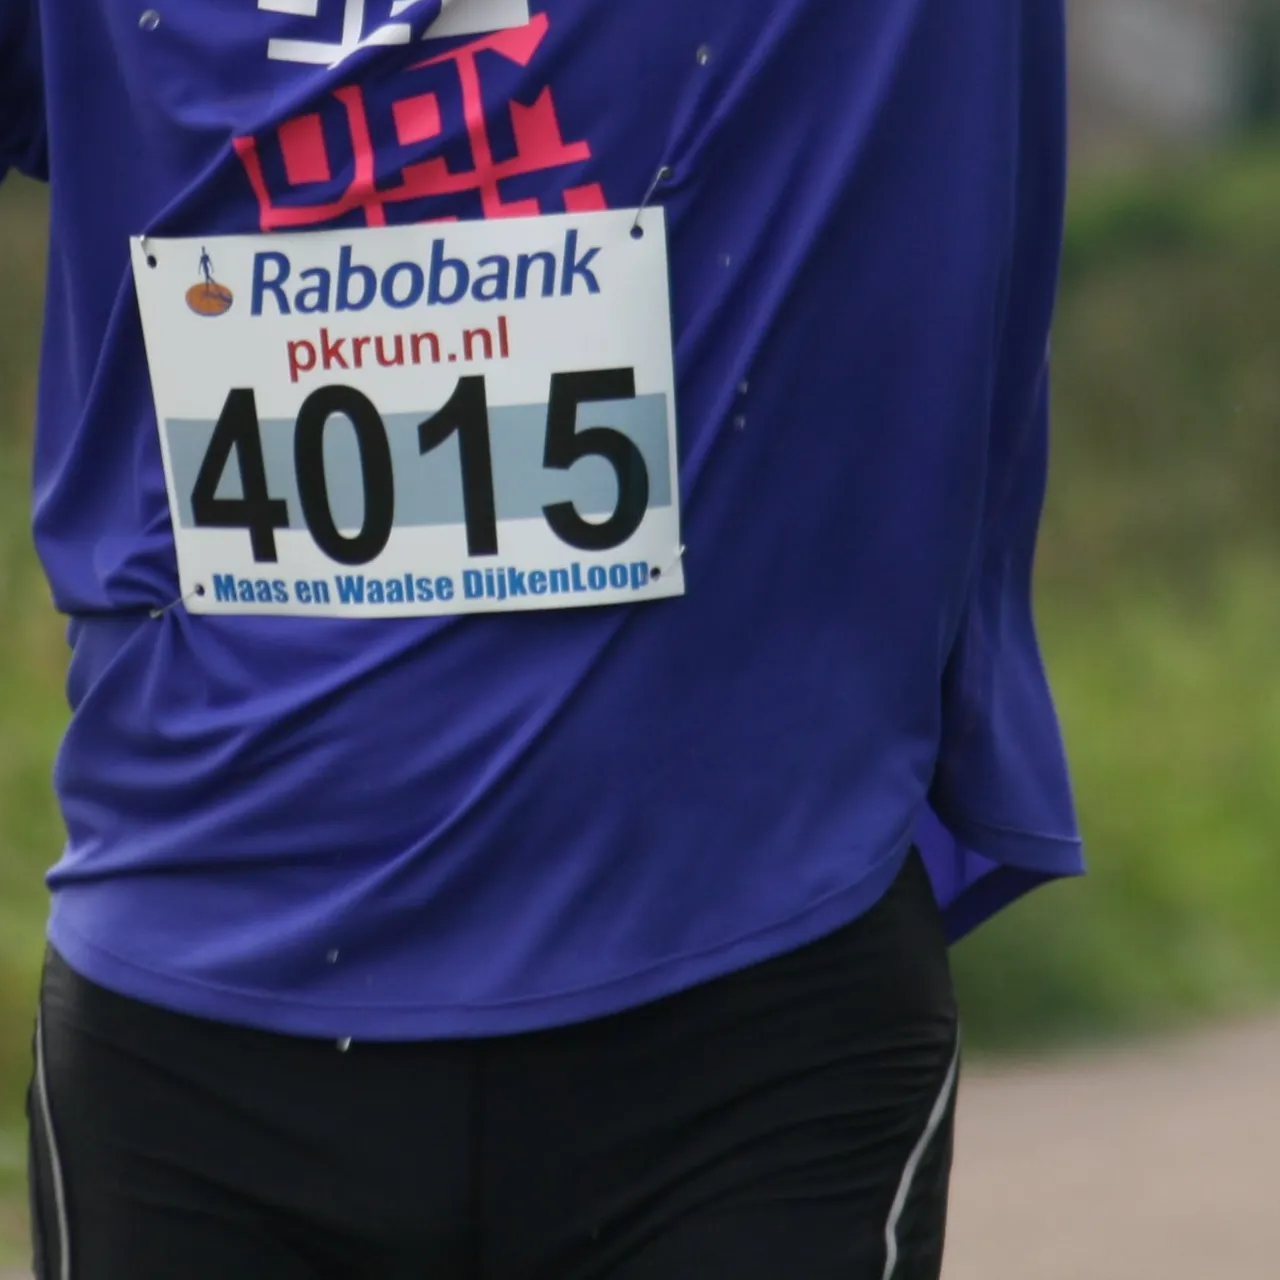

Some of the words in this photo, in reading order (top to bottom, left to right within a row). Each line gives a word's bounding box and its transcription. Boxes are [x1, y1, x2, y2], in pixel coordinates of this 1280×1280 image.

[250, 229, 601, 317] Rabobank
[286, 316, 510, 382] pkrun.nl
[191, 367, 649, 567] 4015
[213, 573, 289, 605] Maas
[295, 578, 330, 603] en
[334, 567, 454, 605] Waalse
[463, 559, 649, 600] DijkenLoop
